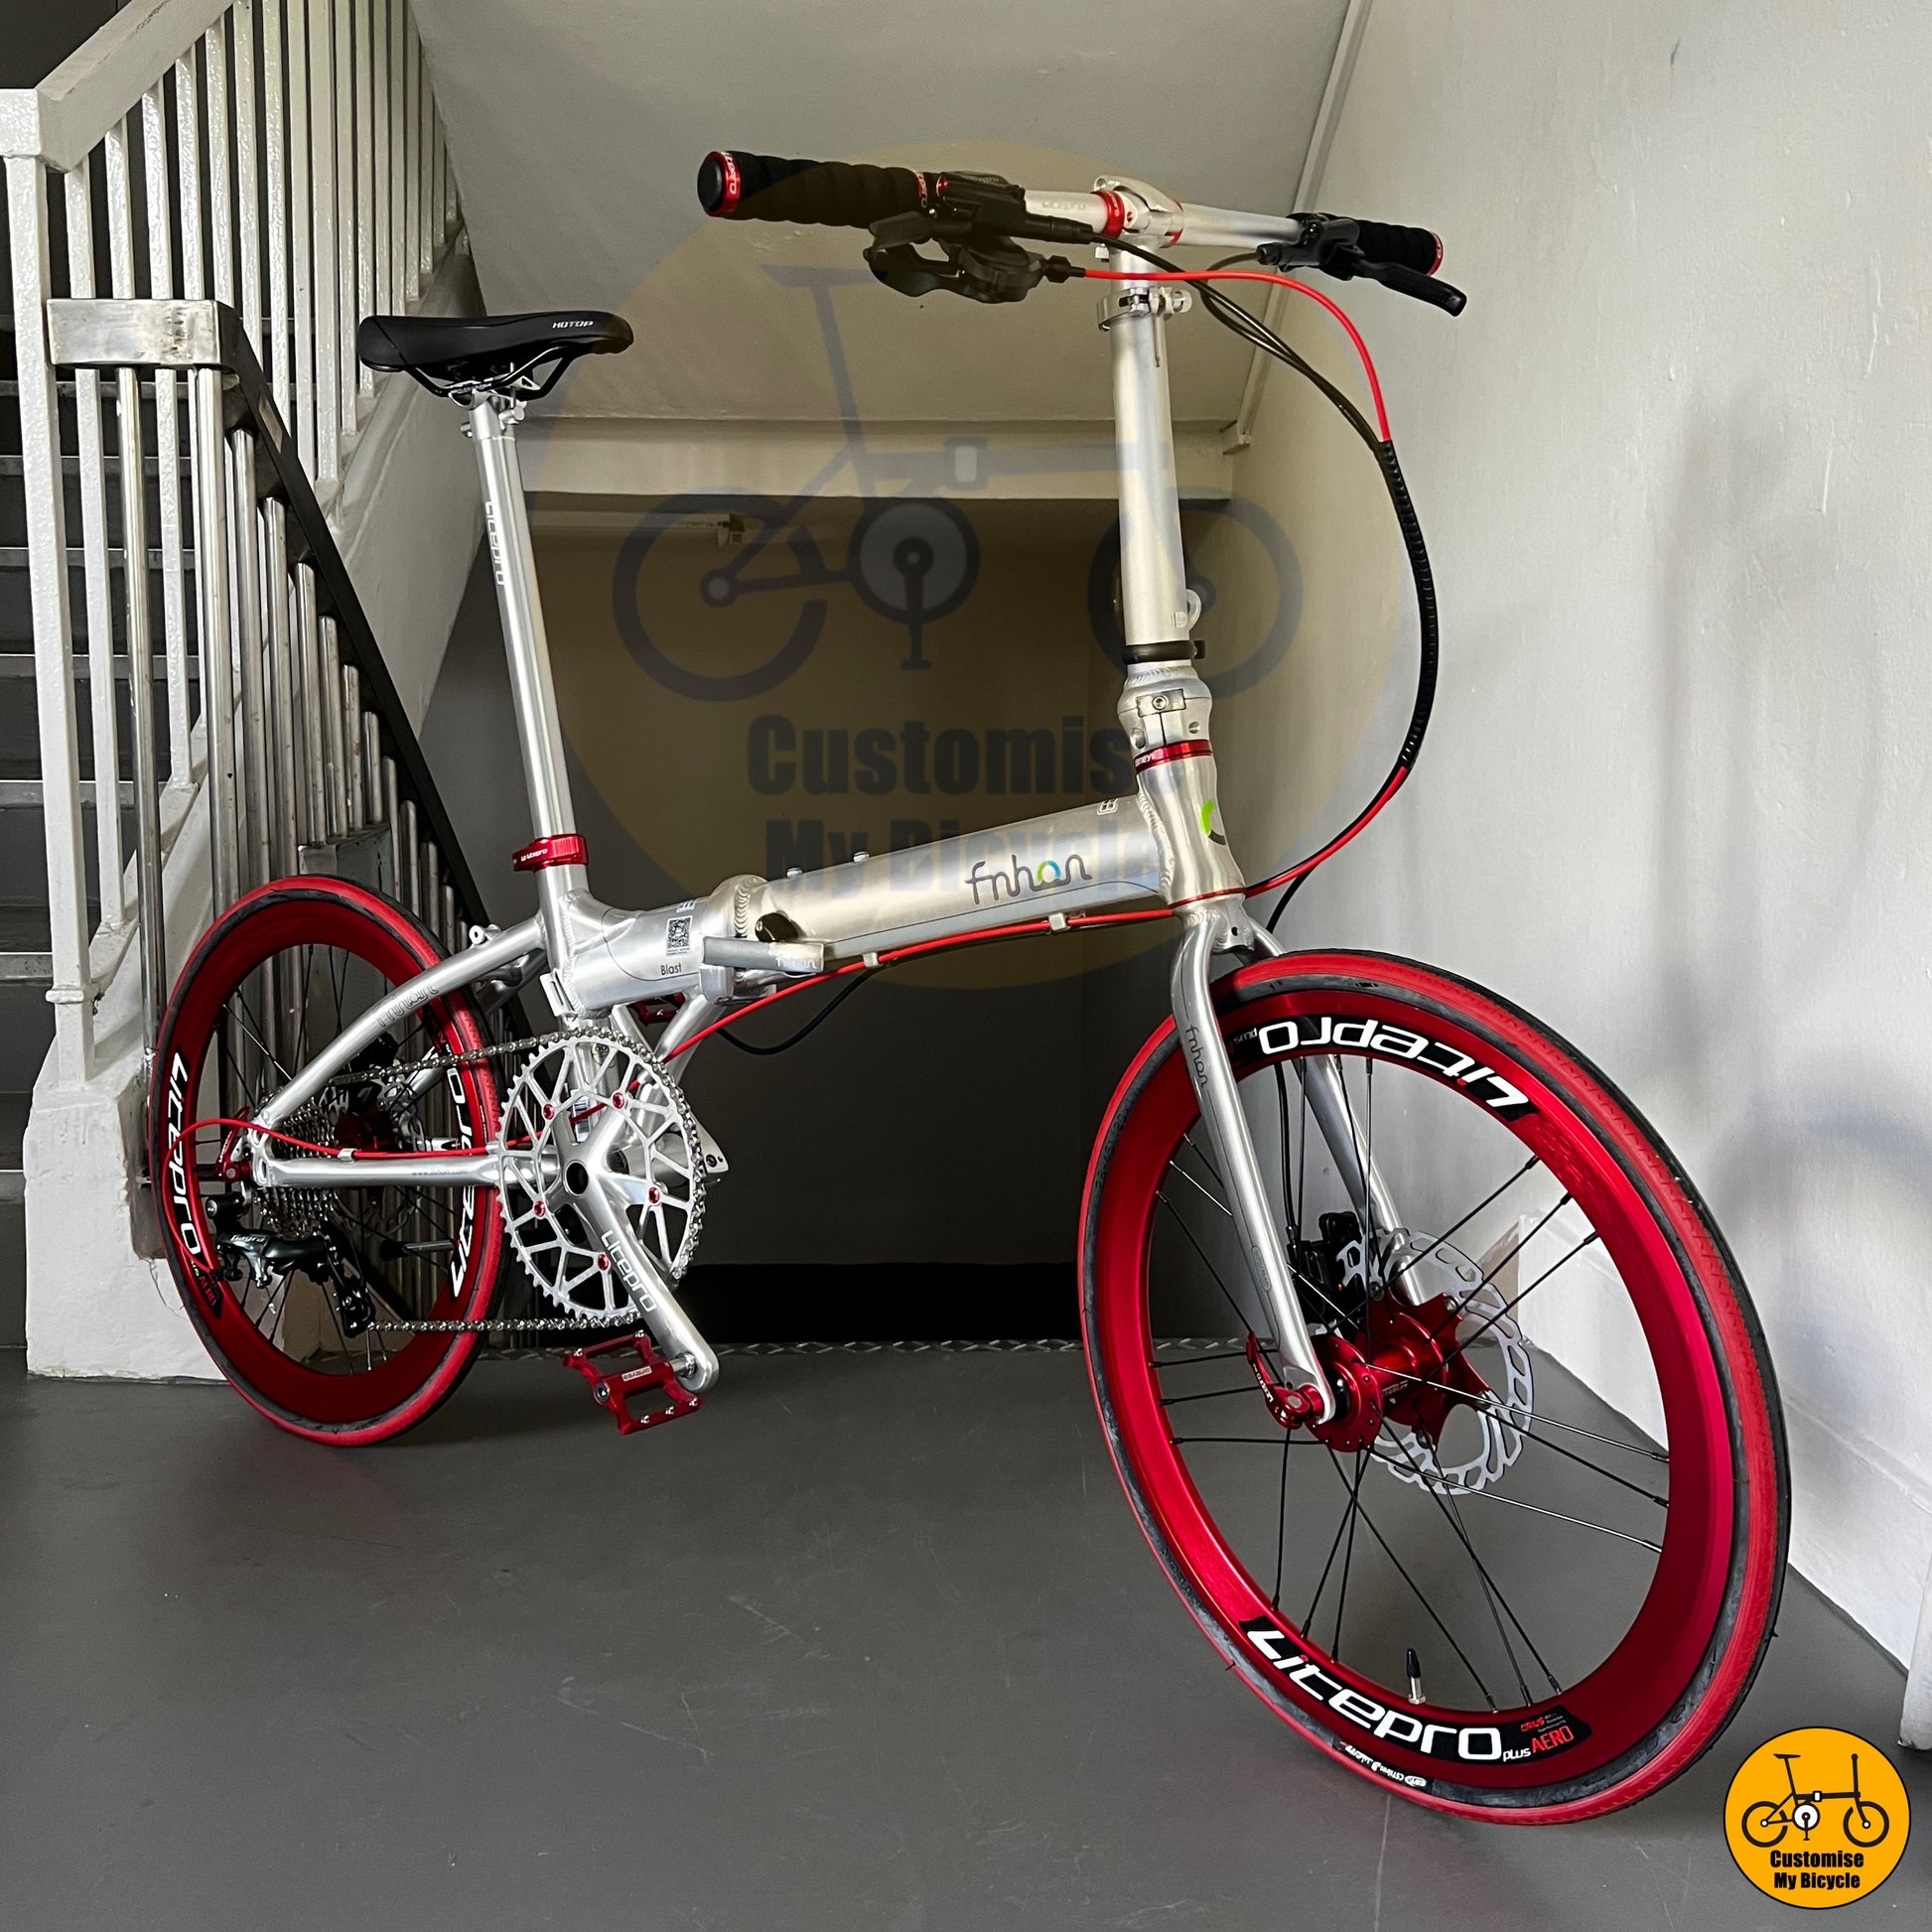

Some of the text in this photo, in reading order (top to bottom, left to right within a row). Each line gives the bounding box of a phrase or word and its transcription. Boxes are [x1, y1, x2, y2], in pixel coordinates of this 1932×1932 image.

[965, 854, 1093, 905] fnhon
[660, 962, 682, 976] Blast
[1185, 1025, 1208, 1088] fnhon
[1258, 1016, 1529, 1108] Litepro
[601, 1229, 658, 1312] Litepro
[1246, 1629, 1532, 1762] Litepro plus
[1532, 1725, 1575, 1754] AERO
